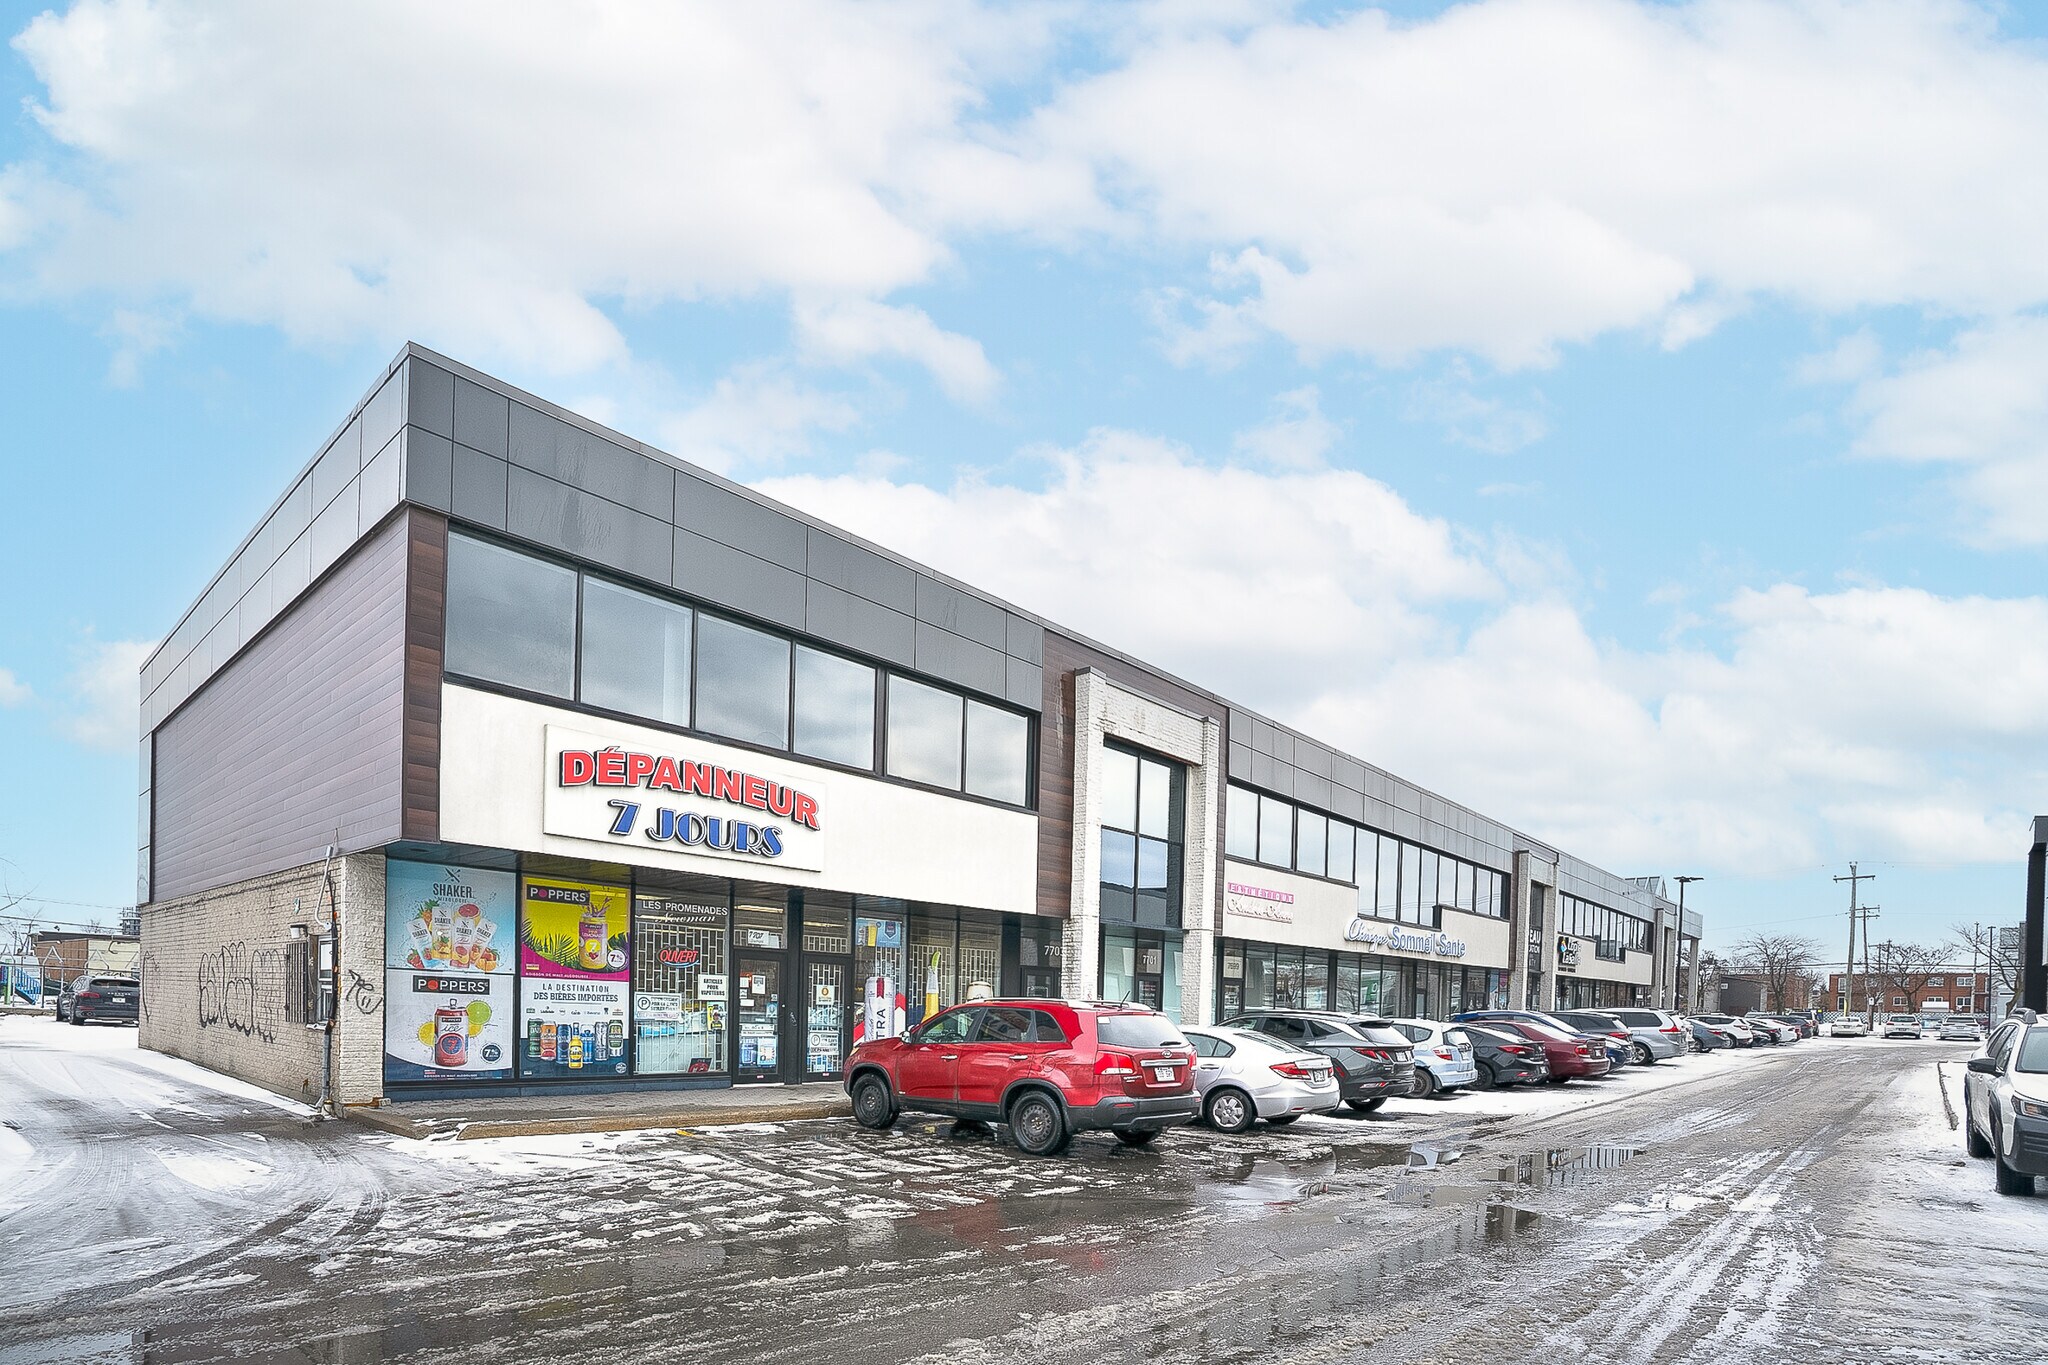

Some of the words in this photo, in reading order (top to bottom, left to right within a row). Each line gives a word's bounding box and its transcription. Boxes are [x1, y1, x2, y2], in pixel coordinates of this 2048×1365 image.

[559, 746, 820, 831] DÉPANNEUR
[608, 800, 641, 836] 7
[647, 807, 783, 858] JOURS
[432, 883, 473, 899] SHAKER
[642, 900, 662, 910] LES
[665, 902, 728, 916] PROMENADES
[654, 912, 715, 923] Newman
[659, 949, 699, 963] OUVERT
[1044, 945, 1062, 956] 770
[1142, 955, 1157, 965] 7701
[542, 983, 553, 991] LA
[556, 984, 609, 993] DESTINATION
[533, 992, 549, 1000] DES
[550, 991, 577, 1001] BIÈRES
[577, 993, 619, 1002] IMPORTÉES
